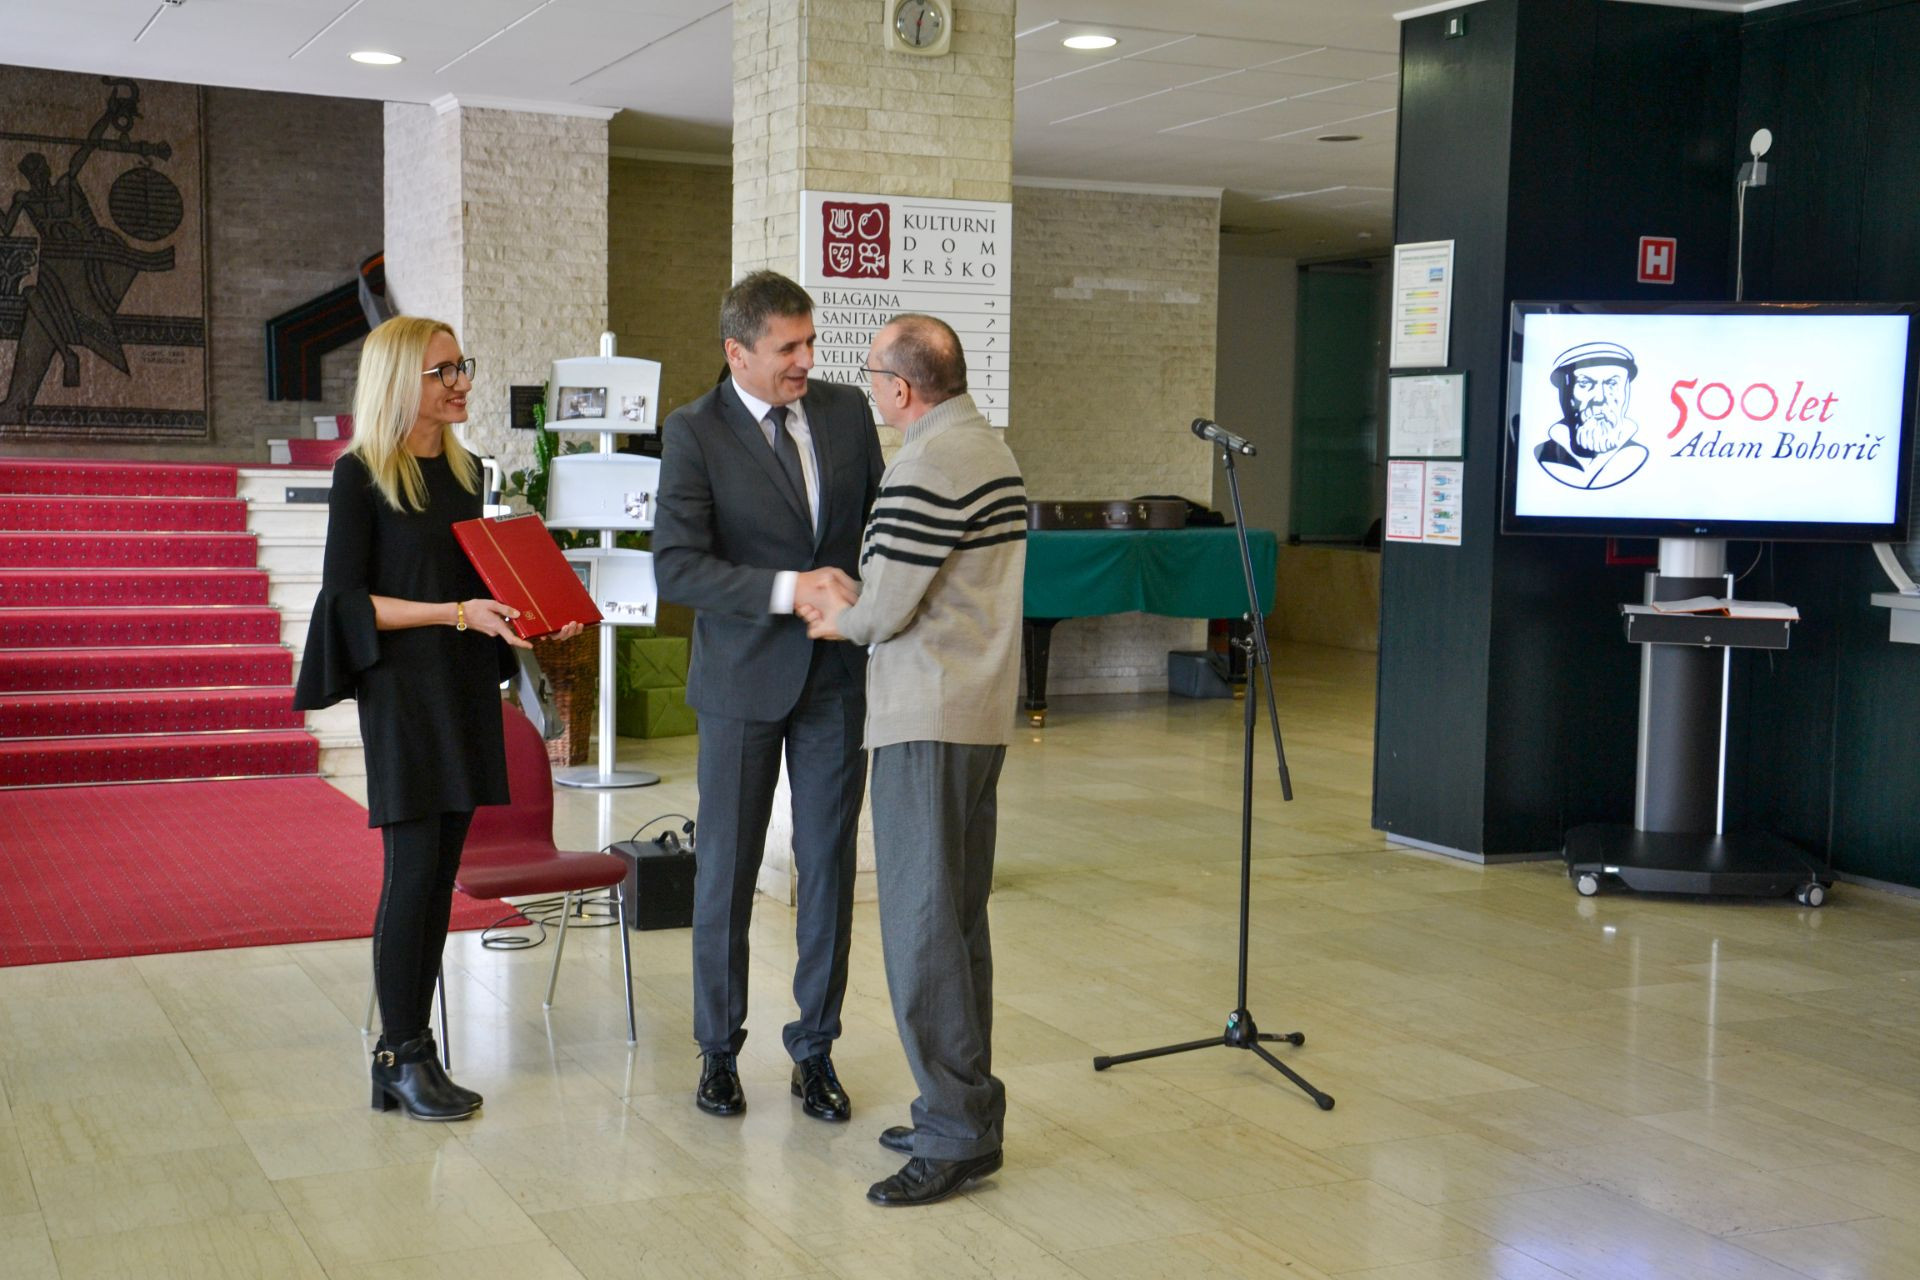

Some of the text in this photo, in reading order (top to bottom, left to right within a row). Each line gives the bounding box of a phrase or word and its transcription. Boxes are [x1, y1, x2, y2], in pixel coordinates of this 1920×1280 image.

[904, 214, 996, 234] KULTURNI
[903, 257, 996, 278] KRŠKO
[1645, 245, 1669, 275] H
[822, 291, 901, 309] BLAGAJNA
[821, 350, 869, 364] VELIK
[821, 370, 864, 383] MALA
[1667, 378, 1839, 439] 500 let
[1671, 430, 1887, 460] Adam Bohorič
